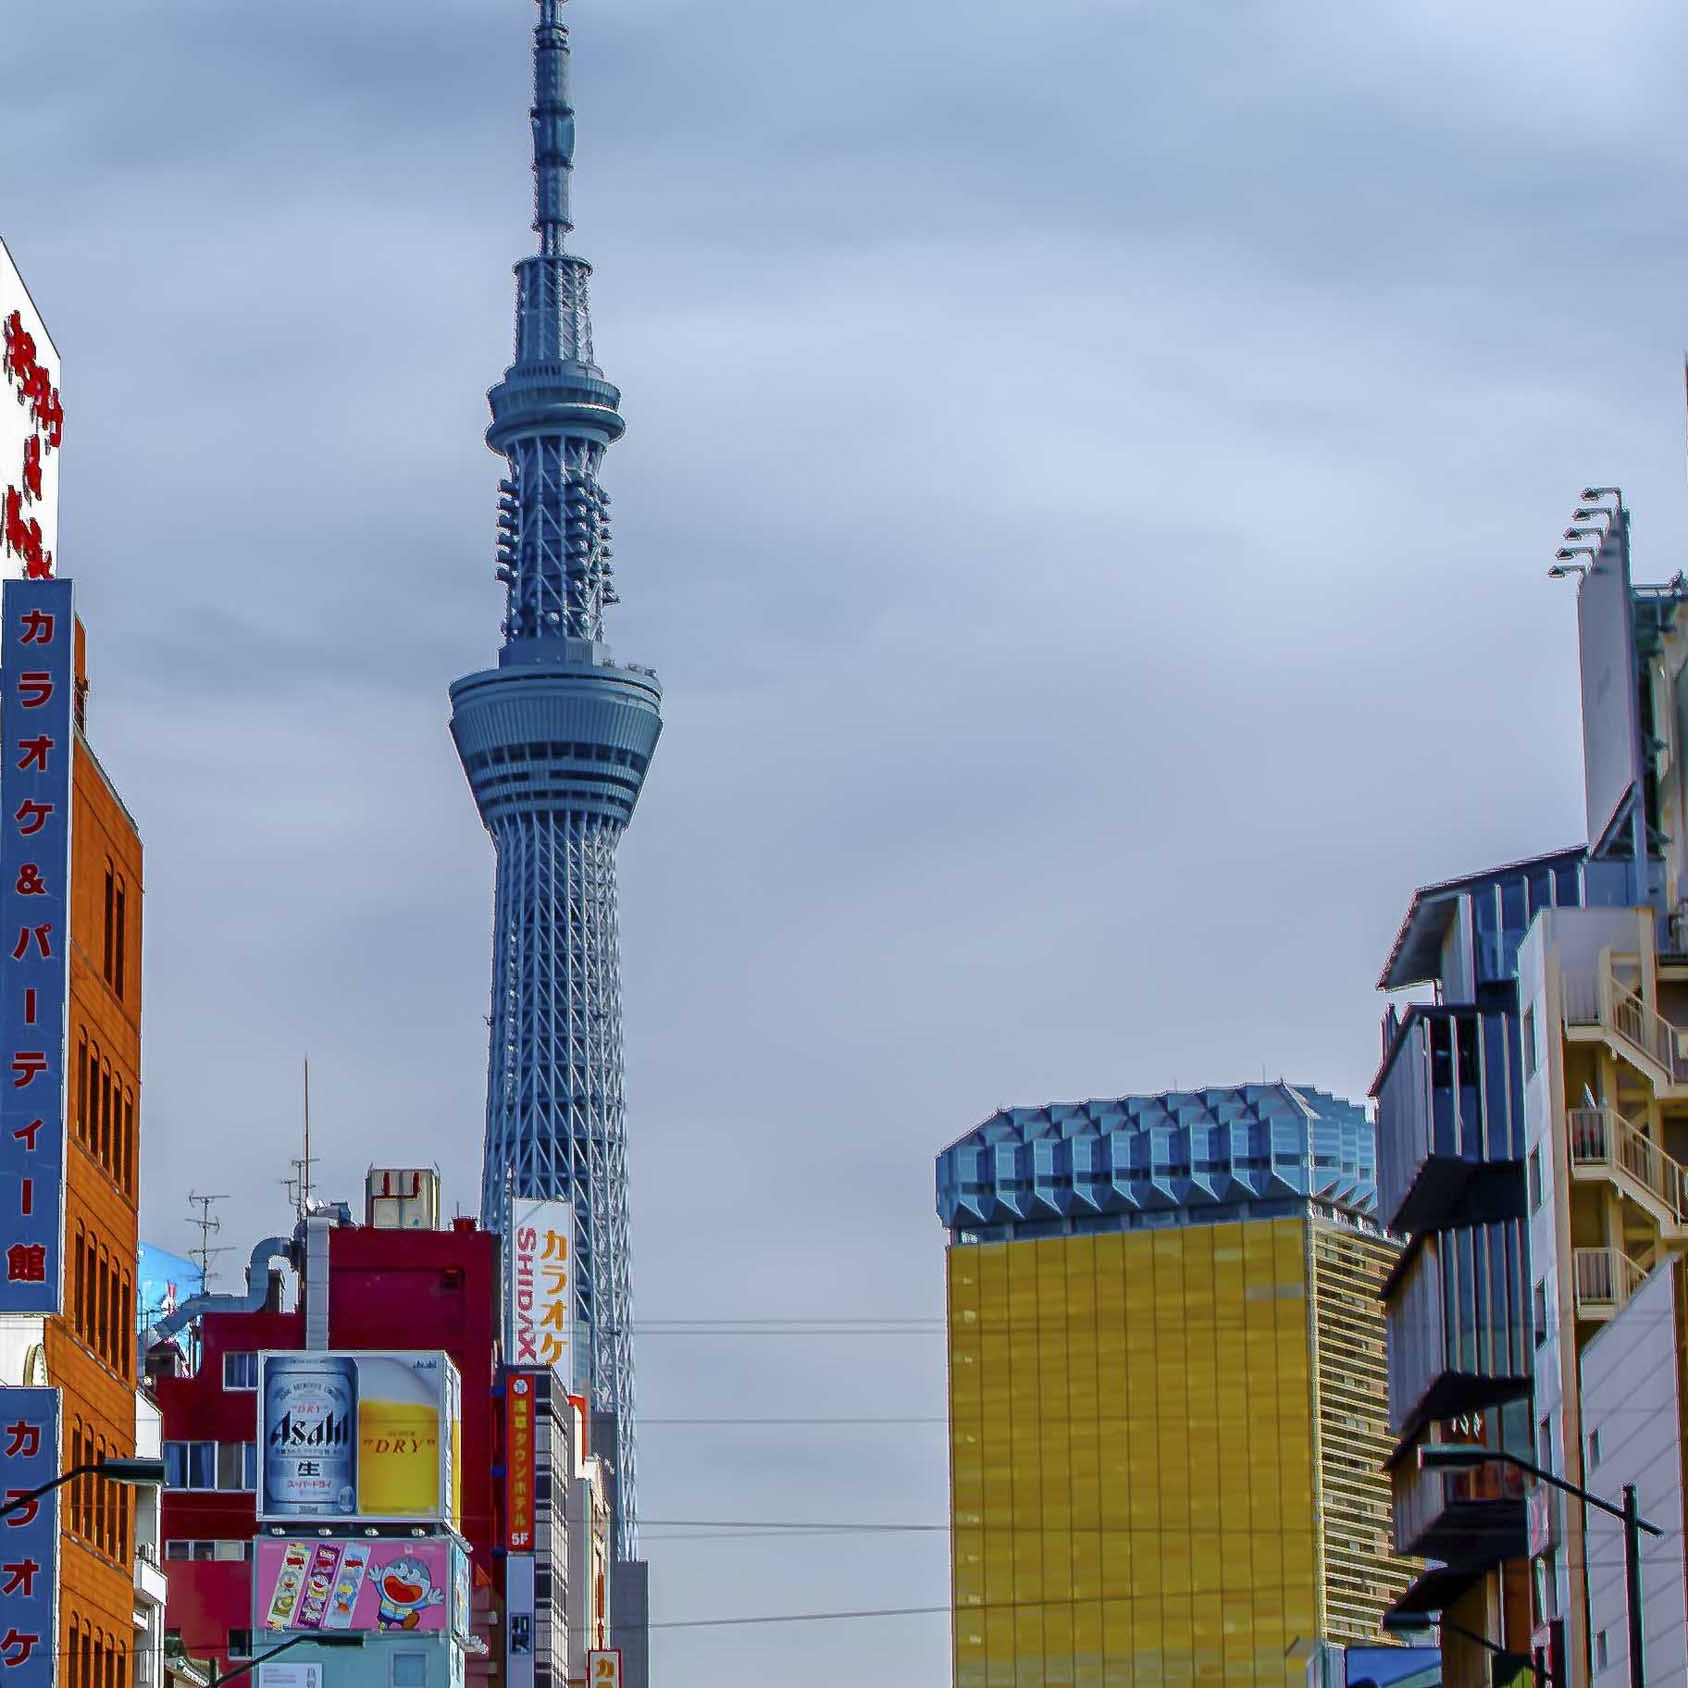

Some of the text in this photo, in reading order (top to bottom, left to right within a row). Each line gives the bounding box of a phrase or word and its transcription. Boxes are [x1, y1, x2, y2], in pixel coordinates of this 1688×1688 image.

[5, 606, 54, 1285] カラオケ&パーティー館
[516, 1226, 538, 1363] SHIDAX
[540, 1229, 568, 1368] カラオケ
[270, 1410, 349, 1448] Asahi
[297, 1460, 321, 1477] 生
